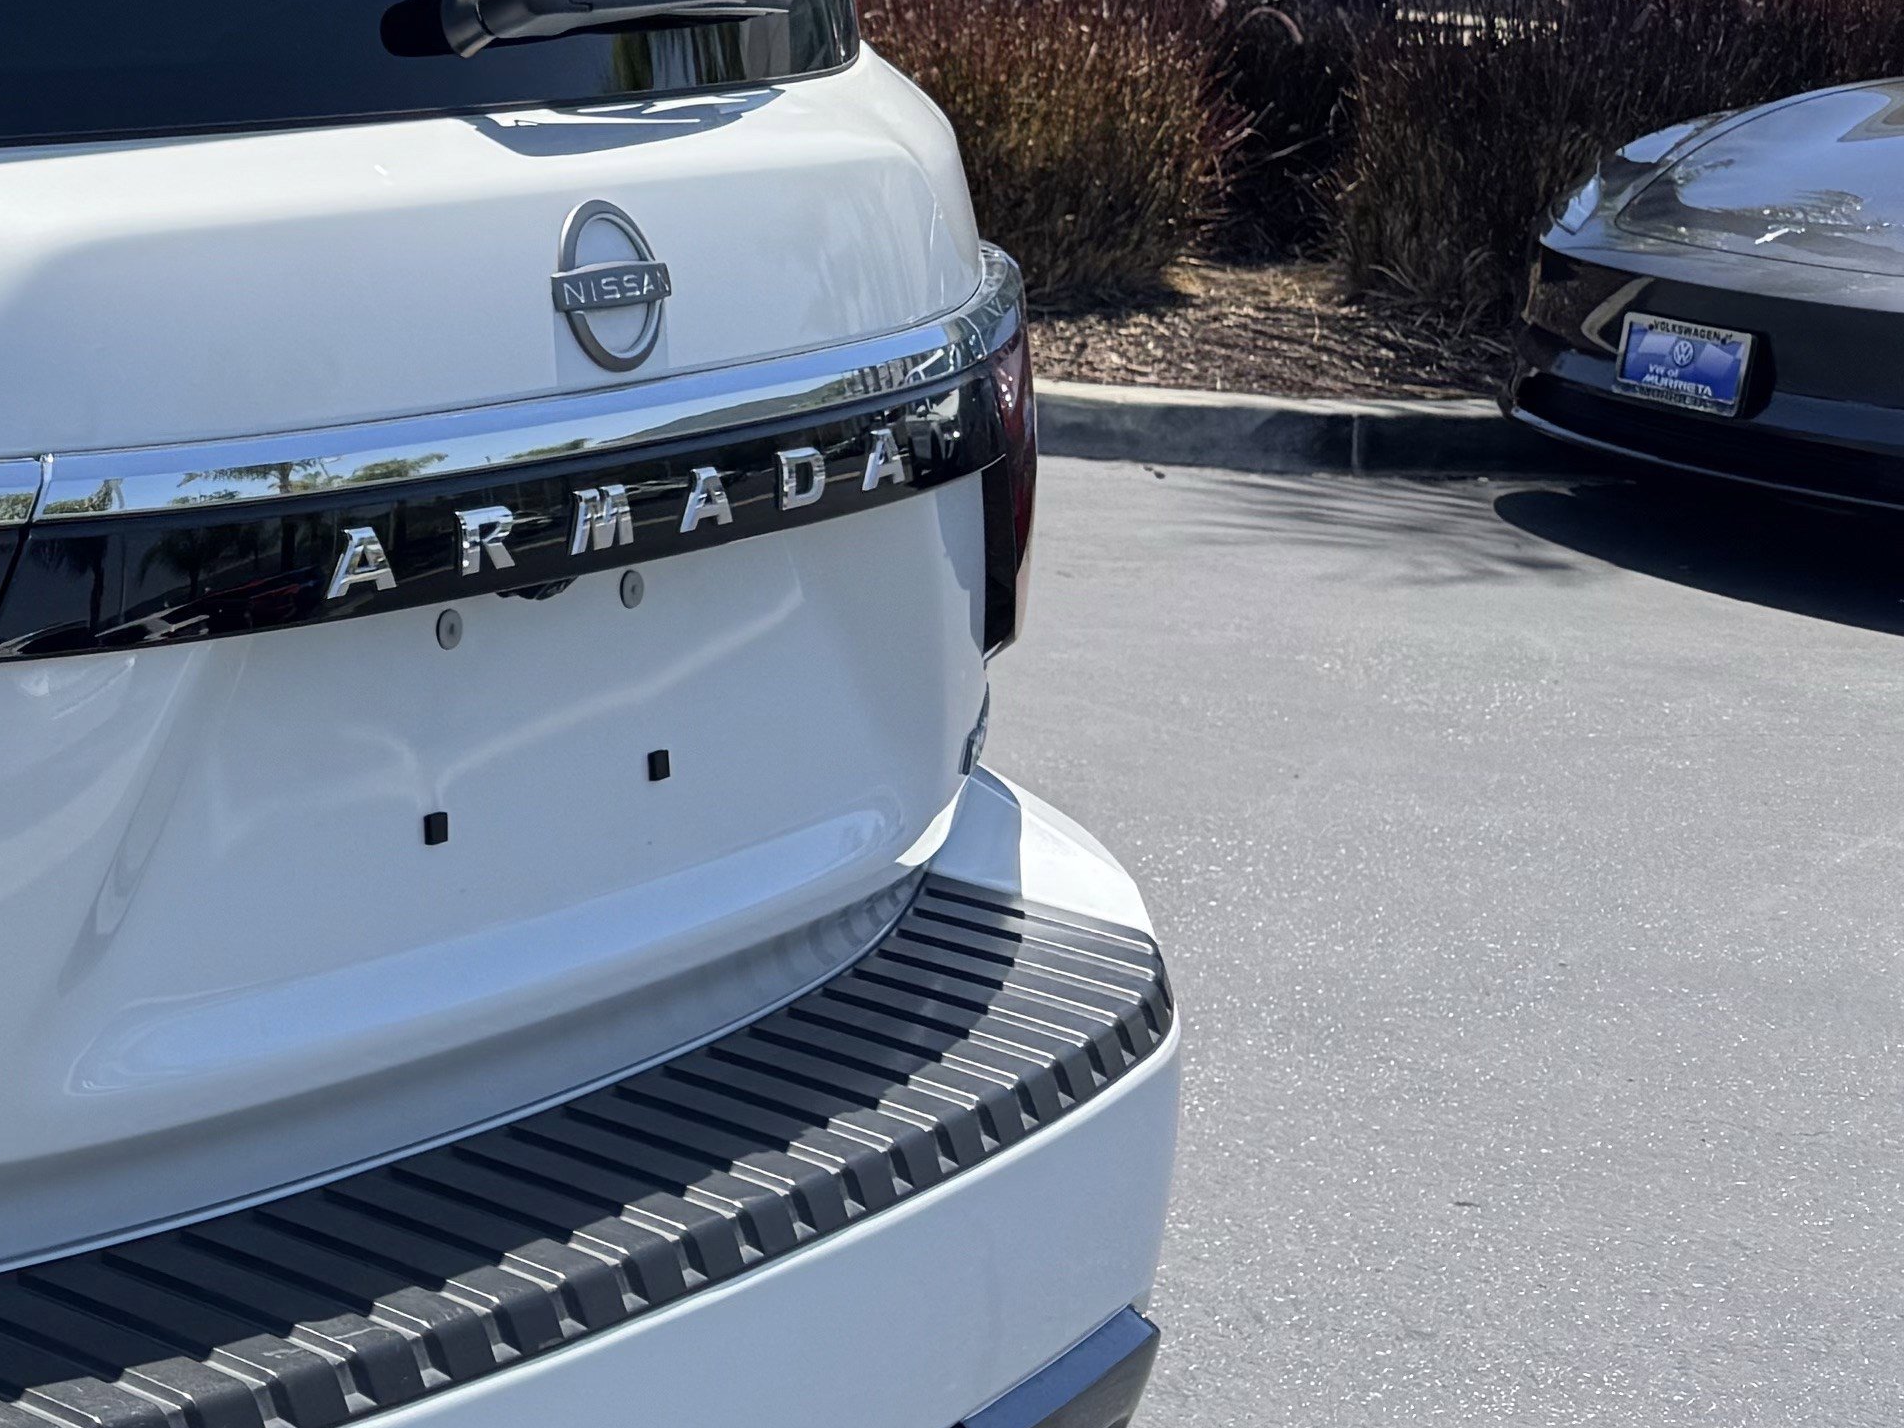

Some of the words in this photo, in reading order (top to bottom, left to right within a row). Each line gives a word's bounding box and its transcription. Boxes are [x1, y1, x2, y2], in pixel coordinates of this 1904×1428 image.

[562, 270, 670, 306] NISSAN
[1653, 319, 1722, 341] VOLKSWAGEN
[326, 427, 906, 600] ARMADA
